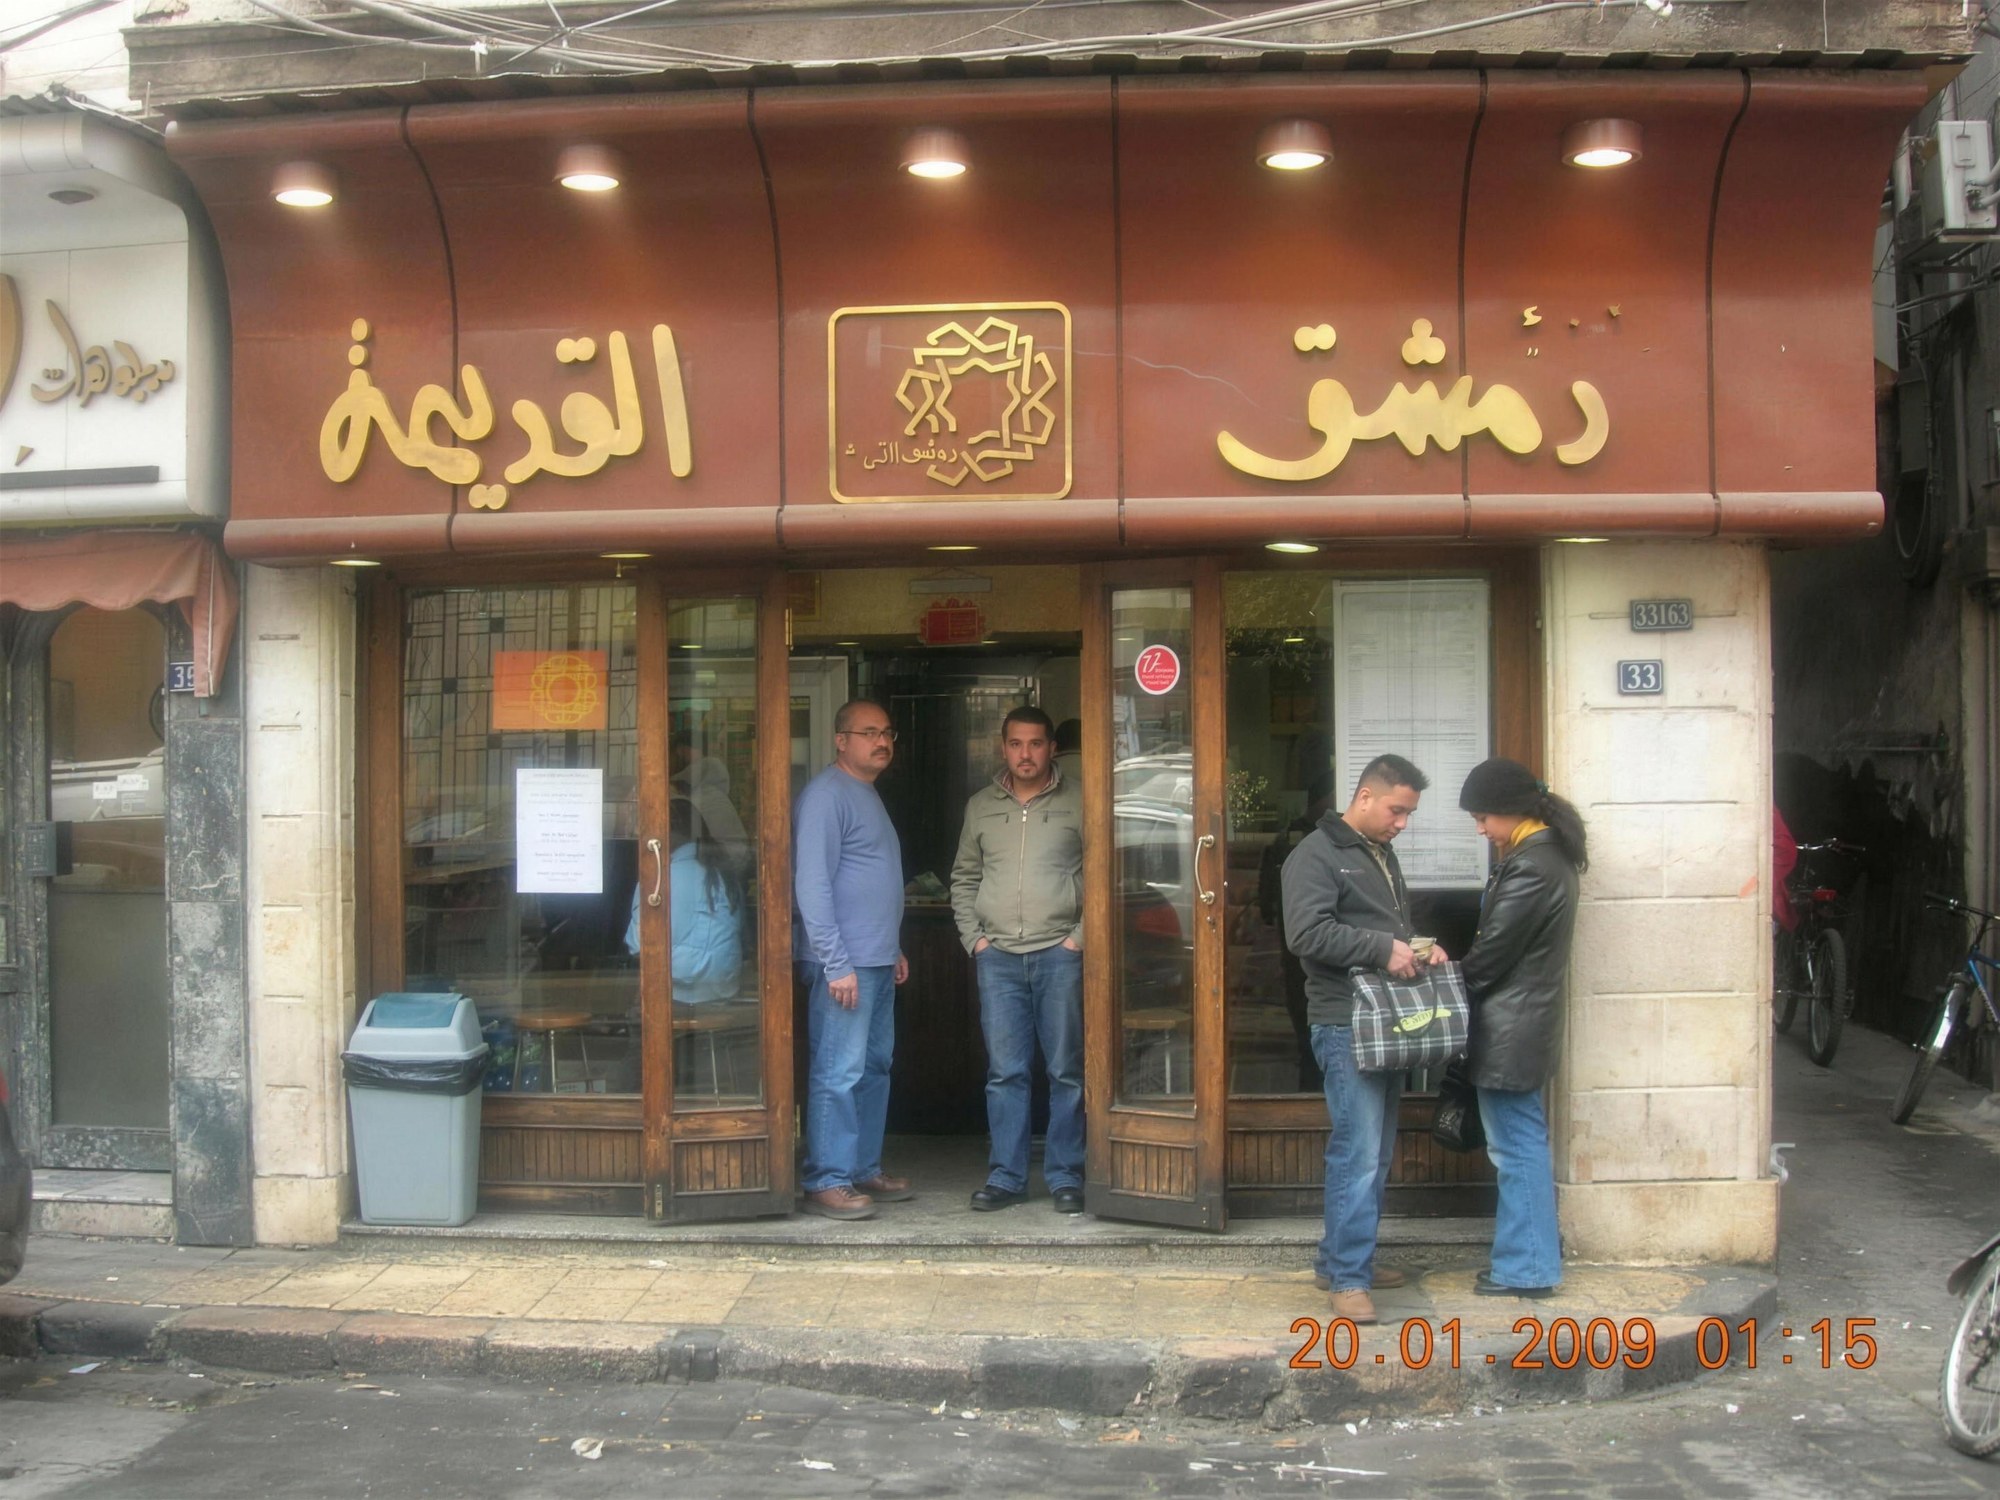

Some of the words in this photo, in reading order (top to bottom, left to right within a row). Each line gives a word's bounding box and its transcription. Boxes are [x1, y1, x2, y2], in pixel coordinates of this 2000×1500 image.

[320, 318, 693, 510] القديمة
[1636, 603, 1689, 627] 33163
[1627, 663, 1656, 689] 33
